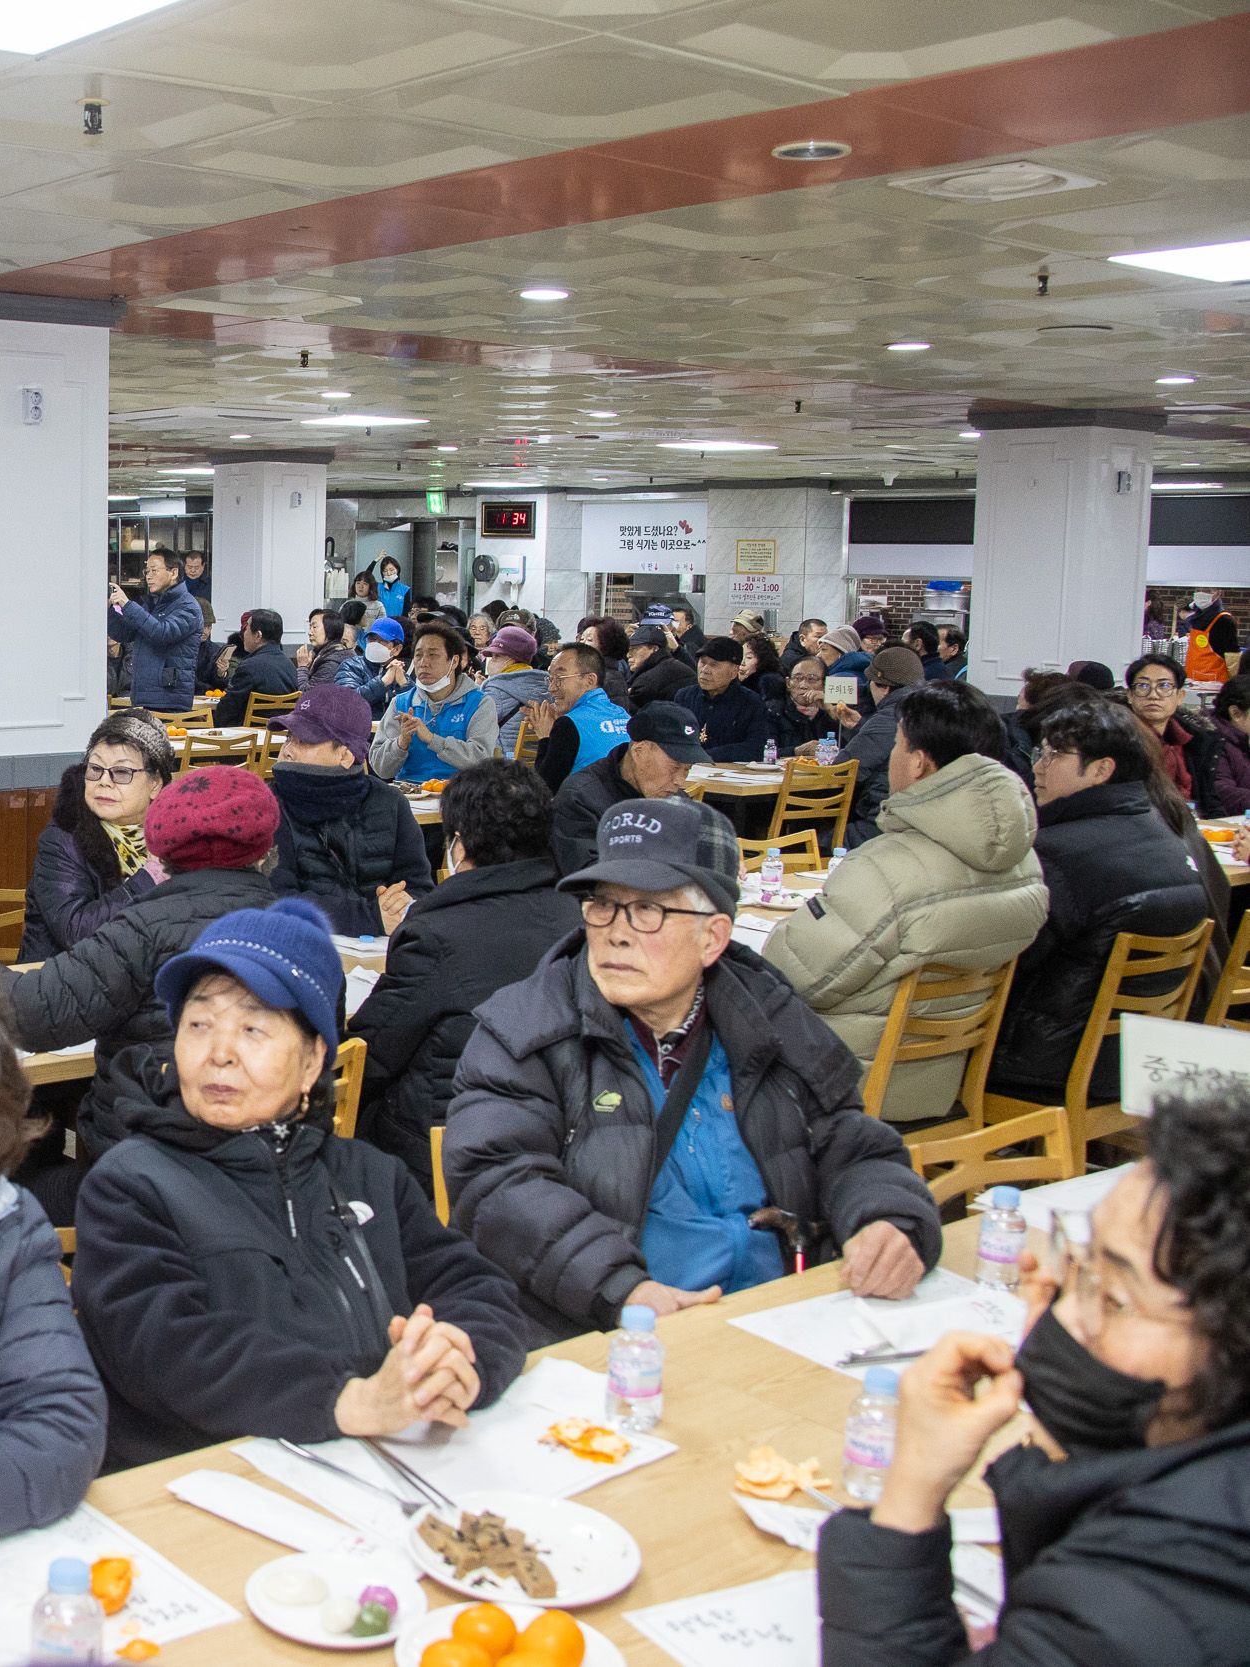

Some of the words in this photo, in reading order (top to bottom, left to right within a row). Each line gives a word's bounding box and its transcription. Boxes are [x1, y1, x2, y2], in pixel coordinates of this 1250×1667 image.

[512, 512, 527, 526] 34
[619, 525, 642, 537] 맛있게
[643, 525, 678, 537] 드셨나요?
[619, 539, 634, 550] 그럼
[636, 539, 658, 550] 식기는
[733, 582, 754, 592] 11:20
[762, 583, 780, 592] 1:00
[828, 684, 855, 695] 구의1동
[609, 834, 643, 846] SPORTS
